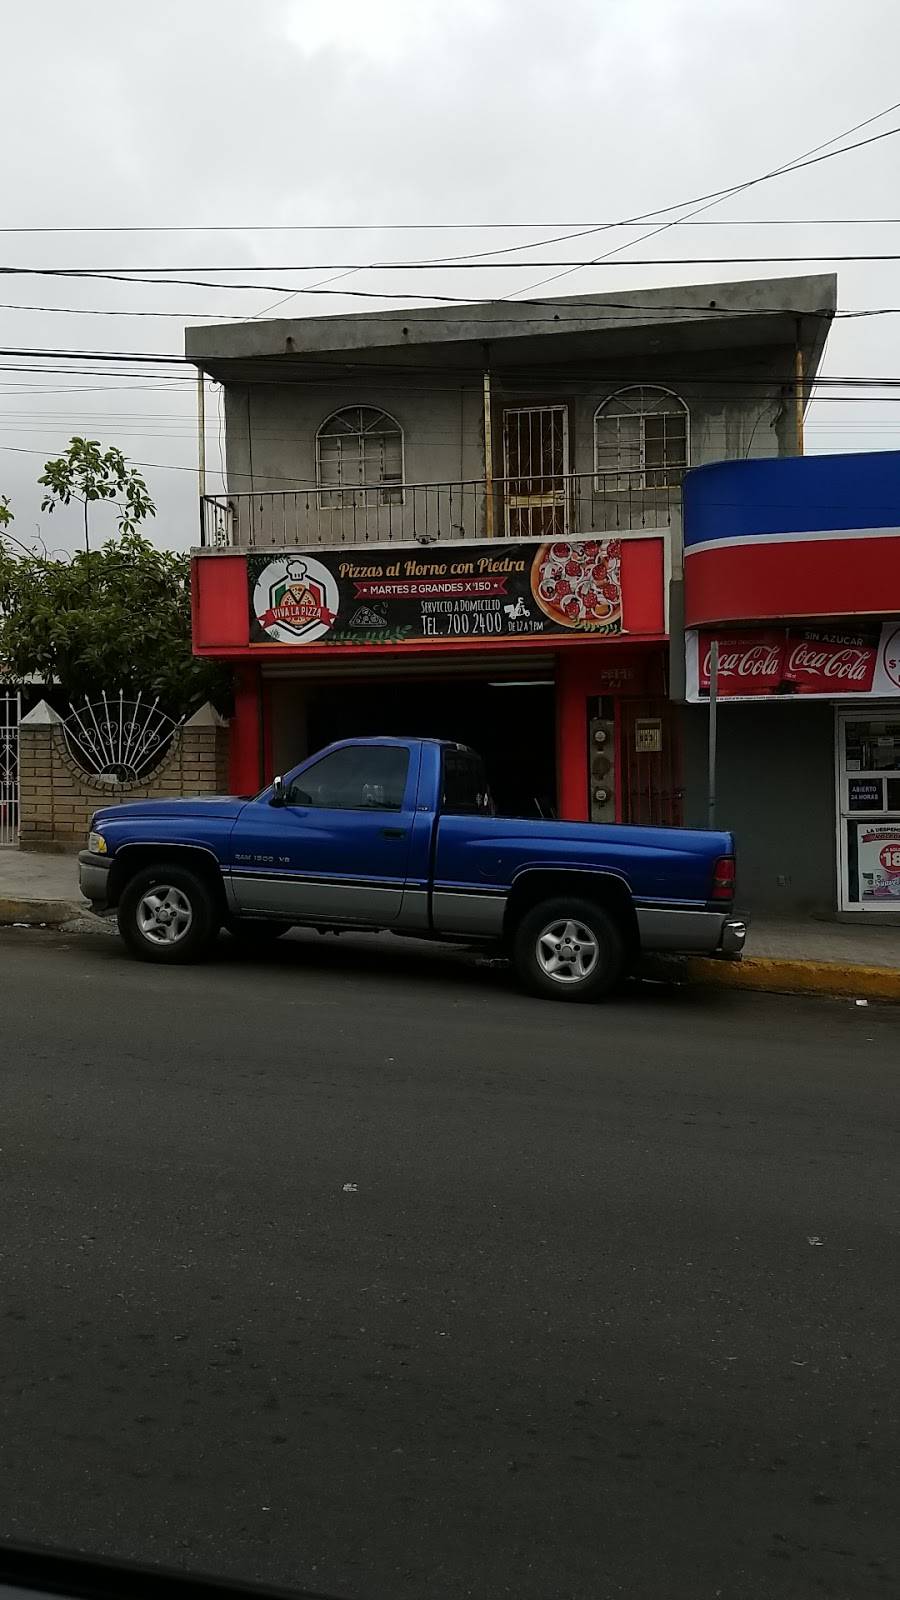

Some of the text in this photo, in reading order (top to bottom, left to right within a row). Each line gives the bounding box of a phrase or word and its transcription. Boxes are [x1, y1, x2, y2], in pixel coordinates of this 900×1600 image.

[338, 557, 526, 578] Pizzas al Horno con Piedra
[370, 585, 409, 595] MARTES
[410, 585, 418, 594] 2
[418, 583, 464, 593] GRANDES
[464, 582, 472, 592] X
[272, 606, 322, 619] VIVA LA PIZZA
[420, 599, 501, 613] SERVICIO A DOMICILIO
[446, 613, 470, 634] 700
[471, 611, 502, 633] 2400
[508, 620, 544, 632] DE 12 A 9 PM
[804, 632, 864, 646] SIN AZUCAR
[703, 645, 781, 676] Cca-Cola
[789, 642, 872, 680] Coca-Cola
